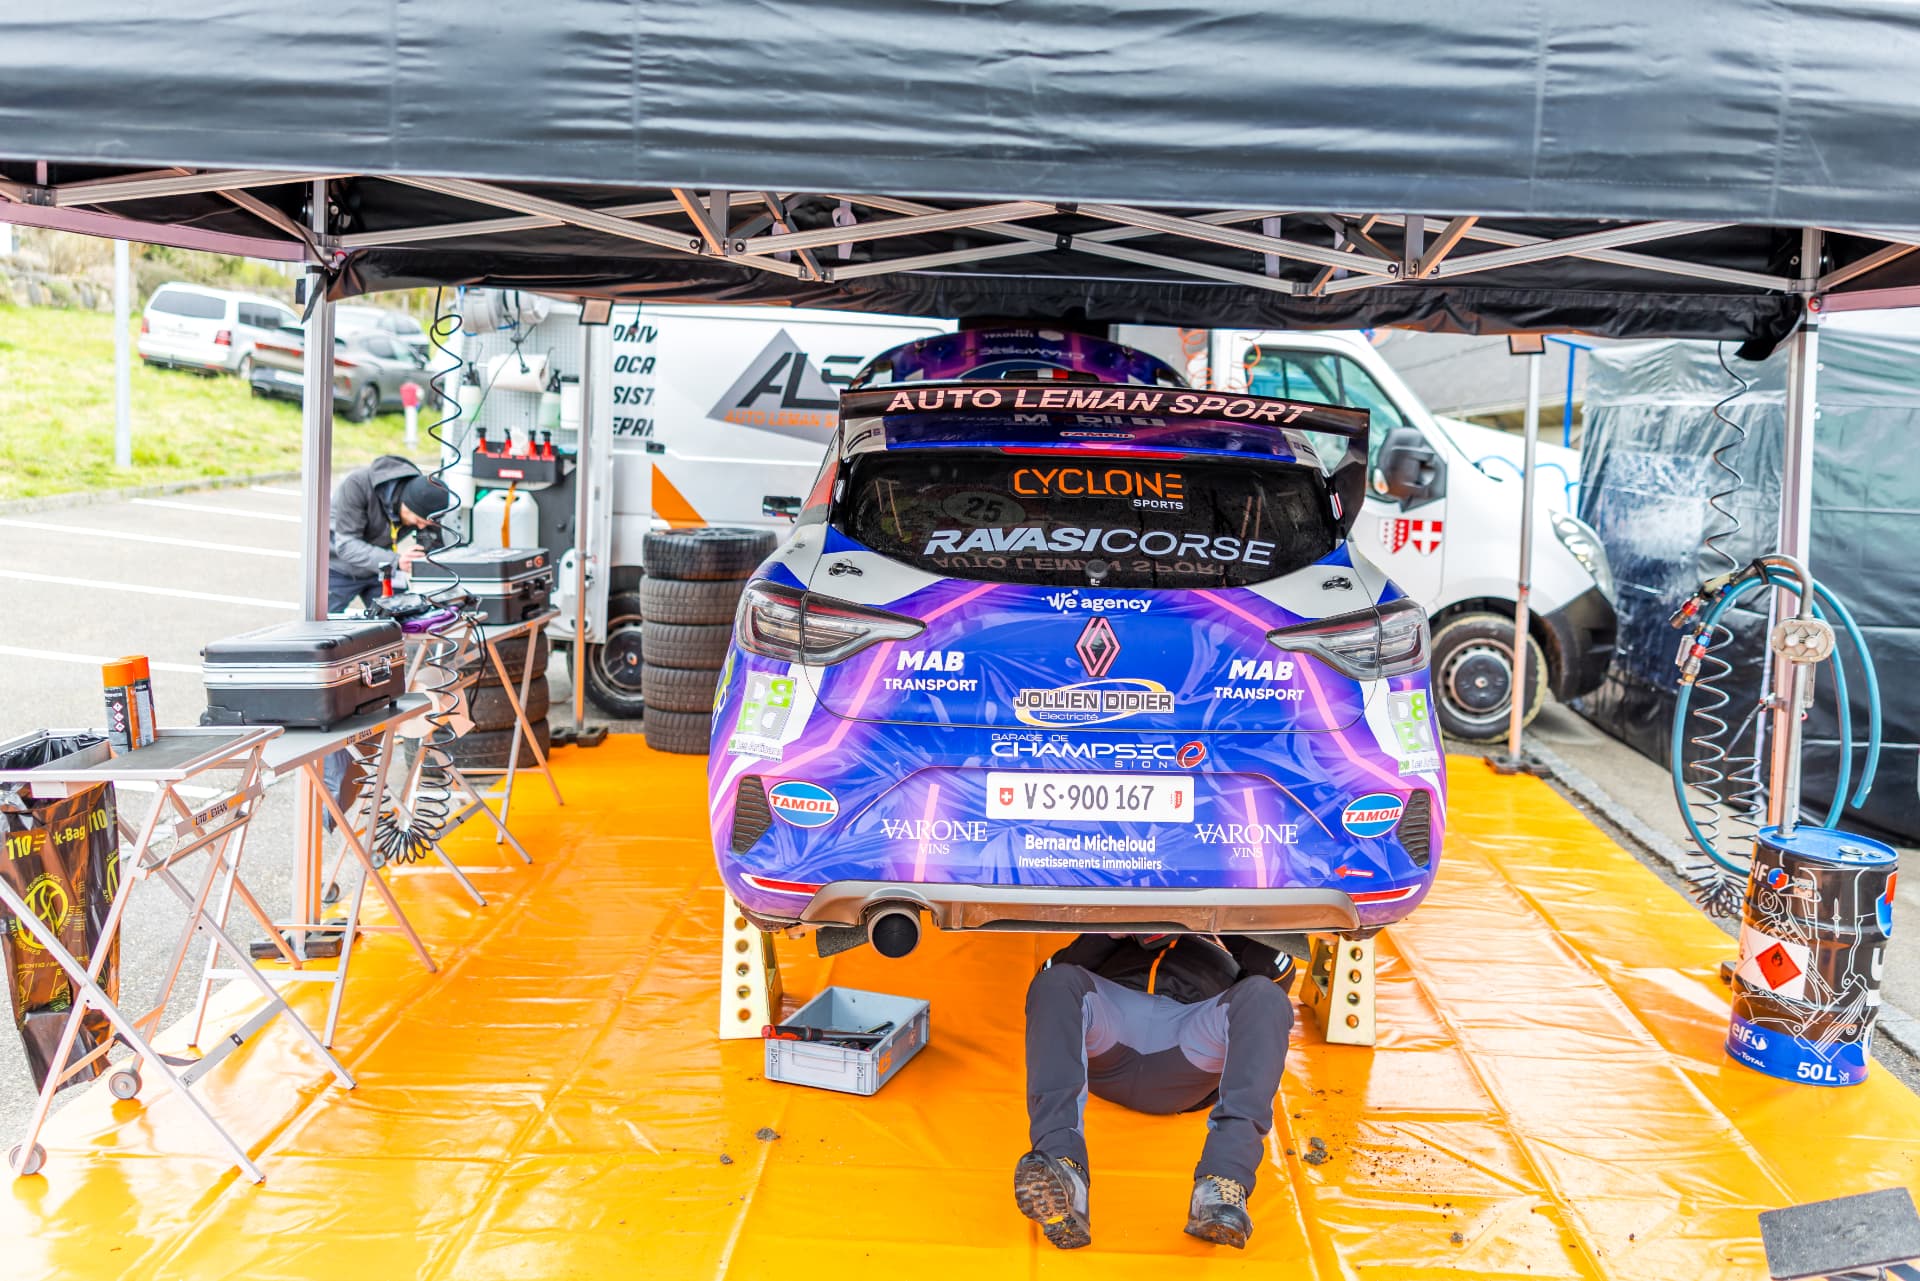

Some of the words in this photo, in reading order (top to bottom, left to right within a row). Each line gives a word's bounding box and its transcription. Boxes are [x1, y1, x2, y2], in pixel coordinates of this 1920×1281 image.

[886, 389, 1001, 412] AUTO
[1014, 389, 1163, 412] LEMAN
[1169, 394, 1314, 424] SPORT
[724, 410, 766, 425] AUTO
[768, 411, 822, 428] LEMAN
[1013, 468, 1184, 499] CYCLONE
[963, 496, 1004, 522] 25
[1133, 499, 1184, 510] SPORTS
[923, 527, 1276, 566] RAVASICORSE
[1081, 598, 1152, 613] agency
[896, 651, 964, 672] MAB
[1228, 659, 1294, 681] MAB
[883, 678, 978, 692] TRANSPORT
[1214, 686, 1305, 701] TRANSPORT
[1014, 691, 1098, 710] JOLLIEN
[1105, 692, 1172, 711] DIDIER
[991, 733, 1043, 742] GARAGE
[1051, 734, 1068, 742] DE
[991, 742, 1175, 760] CHAMPSEC
[1114, 760, 1168, 769] SION
[770, 795, 836, 812] TAMOIL
[1116, 784, 1155, 811] 167
[1345, 810, 1402, 823] TAMOIL
[880, 818, 988, 842] VARONE
[1194, 823, 1299, 845] VARONE
[6, 835, 33, 861] 110
[919, 843, 950, 856] VINS
[1025, 834, 1081, 851] Bernard
[1084, 835, 1156, 852] Micheloud
[1232, 847, 1263, 858] VINS
[1018, 855, 1100, 868] Investissements
[1102, 856, 1162, 870] immobiliers
[1731, 1022, 1752, 1043] elf
[1741, 1051, 1766, 1068] TOTAL
